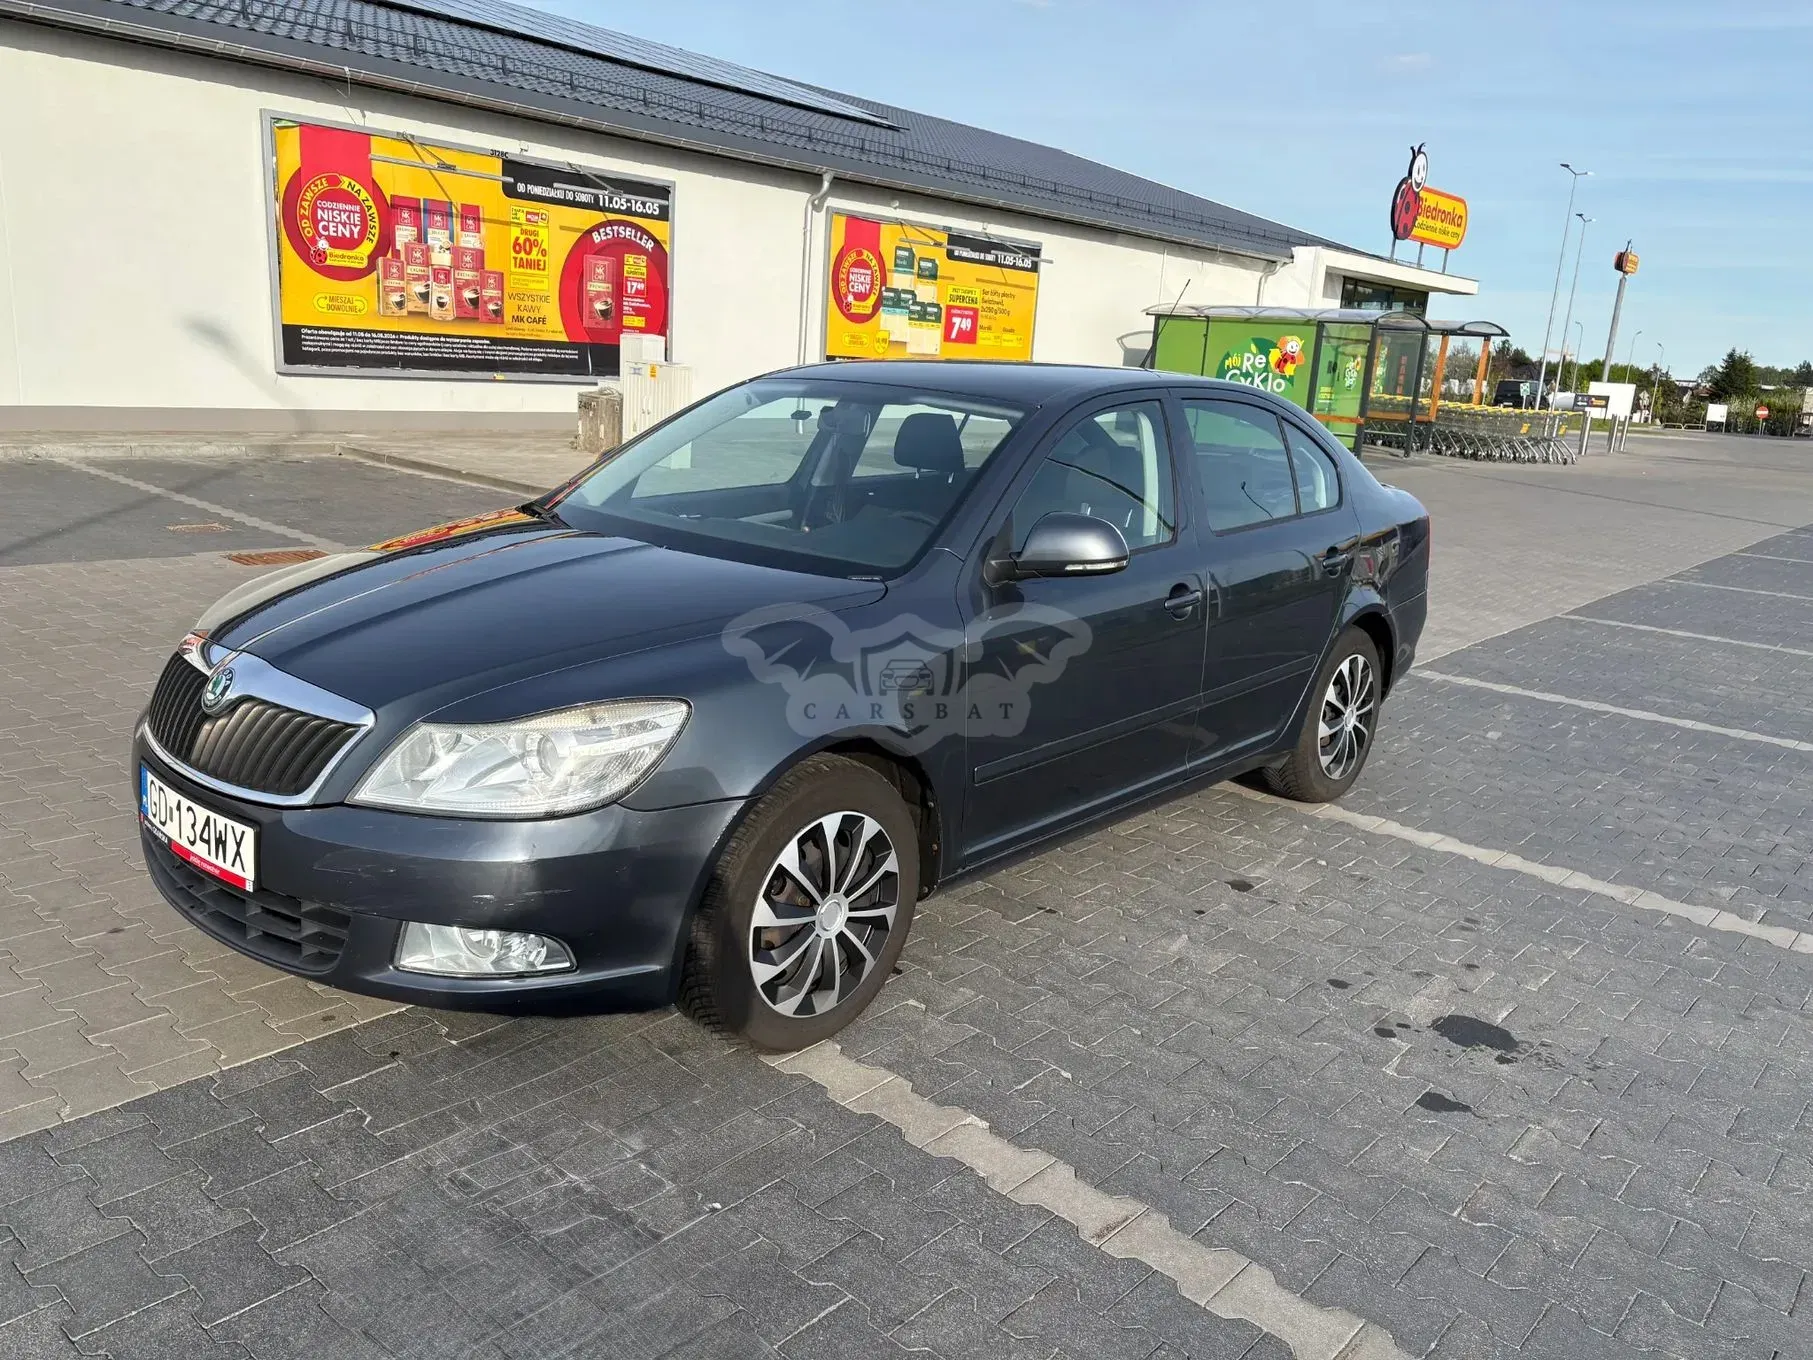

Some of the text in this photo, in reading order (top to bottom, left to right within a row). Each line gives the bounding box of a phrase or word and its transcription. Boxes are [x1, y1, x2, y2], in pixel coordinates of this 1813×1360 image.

[490, 149, 509, 159] 3128C
[317, 200, 360, 212] CODZIENNIE
[517, 183, 660, 215] OD PONIEDZIAŁKU DO SOBOTY 11.05-16.05
[300, 178, 329, 237] OD ZAWSZE
[347, 182, 377, 244] NA ZAWSZE
[317, 209, 361, 225] NISKIE
[318, 222, 361, 239] CENY
[520, 228, 539, 237] DRUGI
[592, 225, 655, 252] BESTSELLER
[512, 236, 547, 257] 60%
[513, 257, 546, 271] TANIEJ
[849, 273, 871, 283] NISKIE
[849, 283, 870, 294] CENY
[329, 295, 354, 305] MIESZAJ
[508, 292, 550, 303] WSZYSTKIE
[517, 304, 541, 313] KAWY
[512, 315, 547, 325] MK CAFÉ
[1242, 352, 1267, 374] Re
[149, 779, 246, 873] GD 134WX
